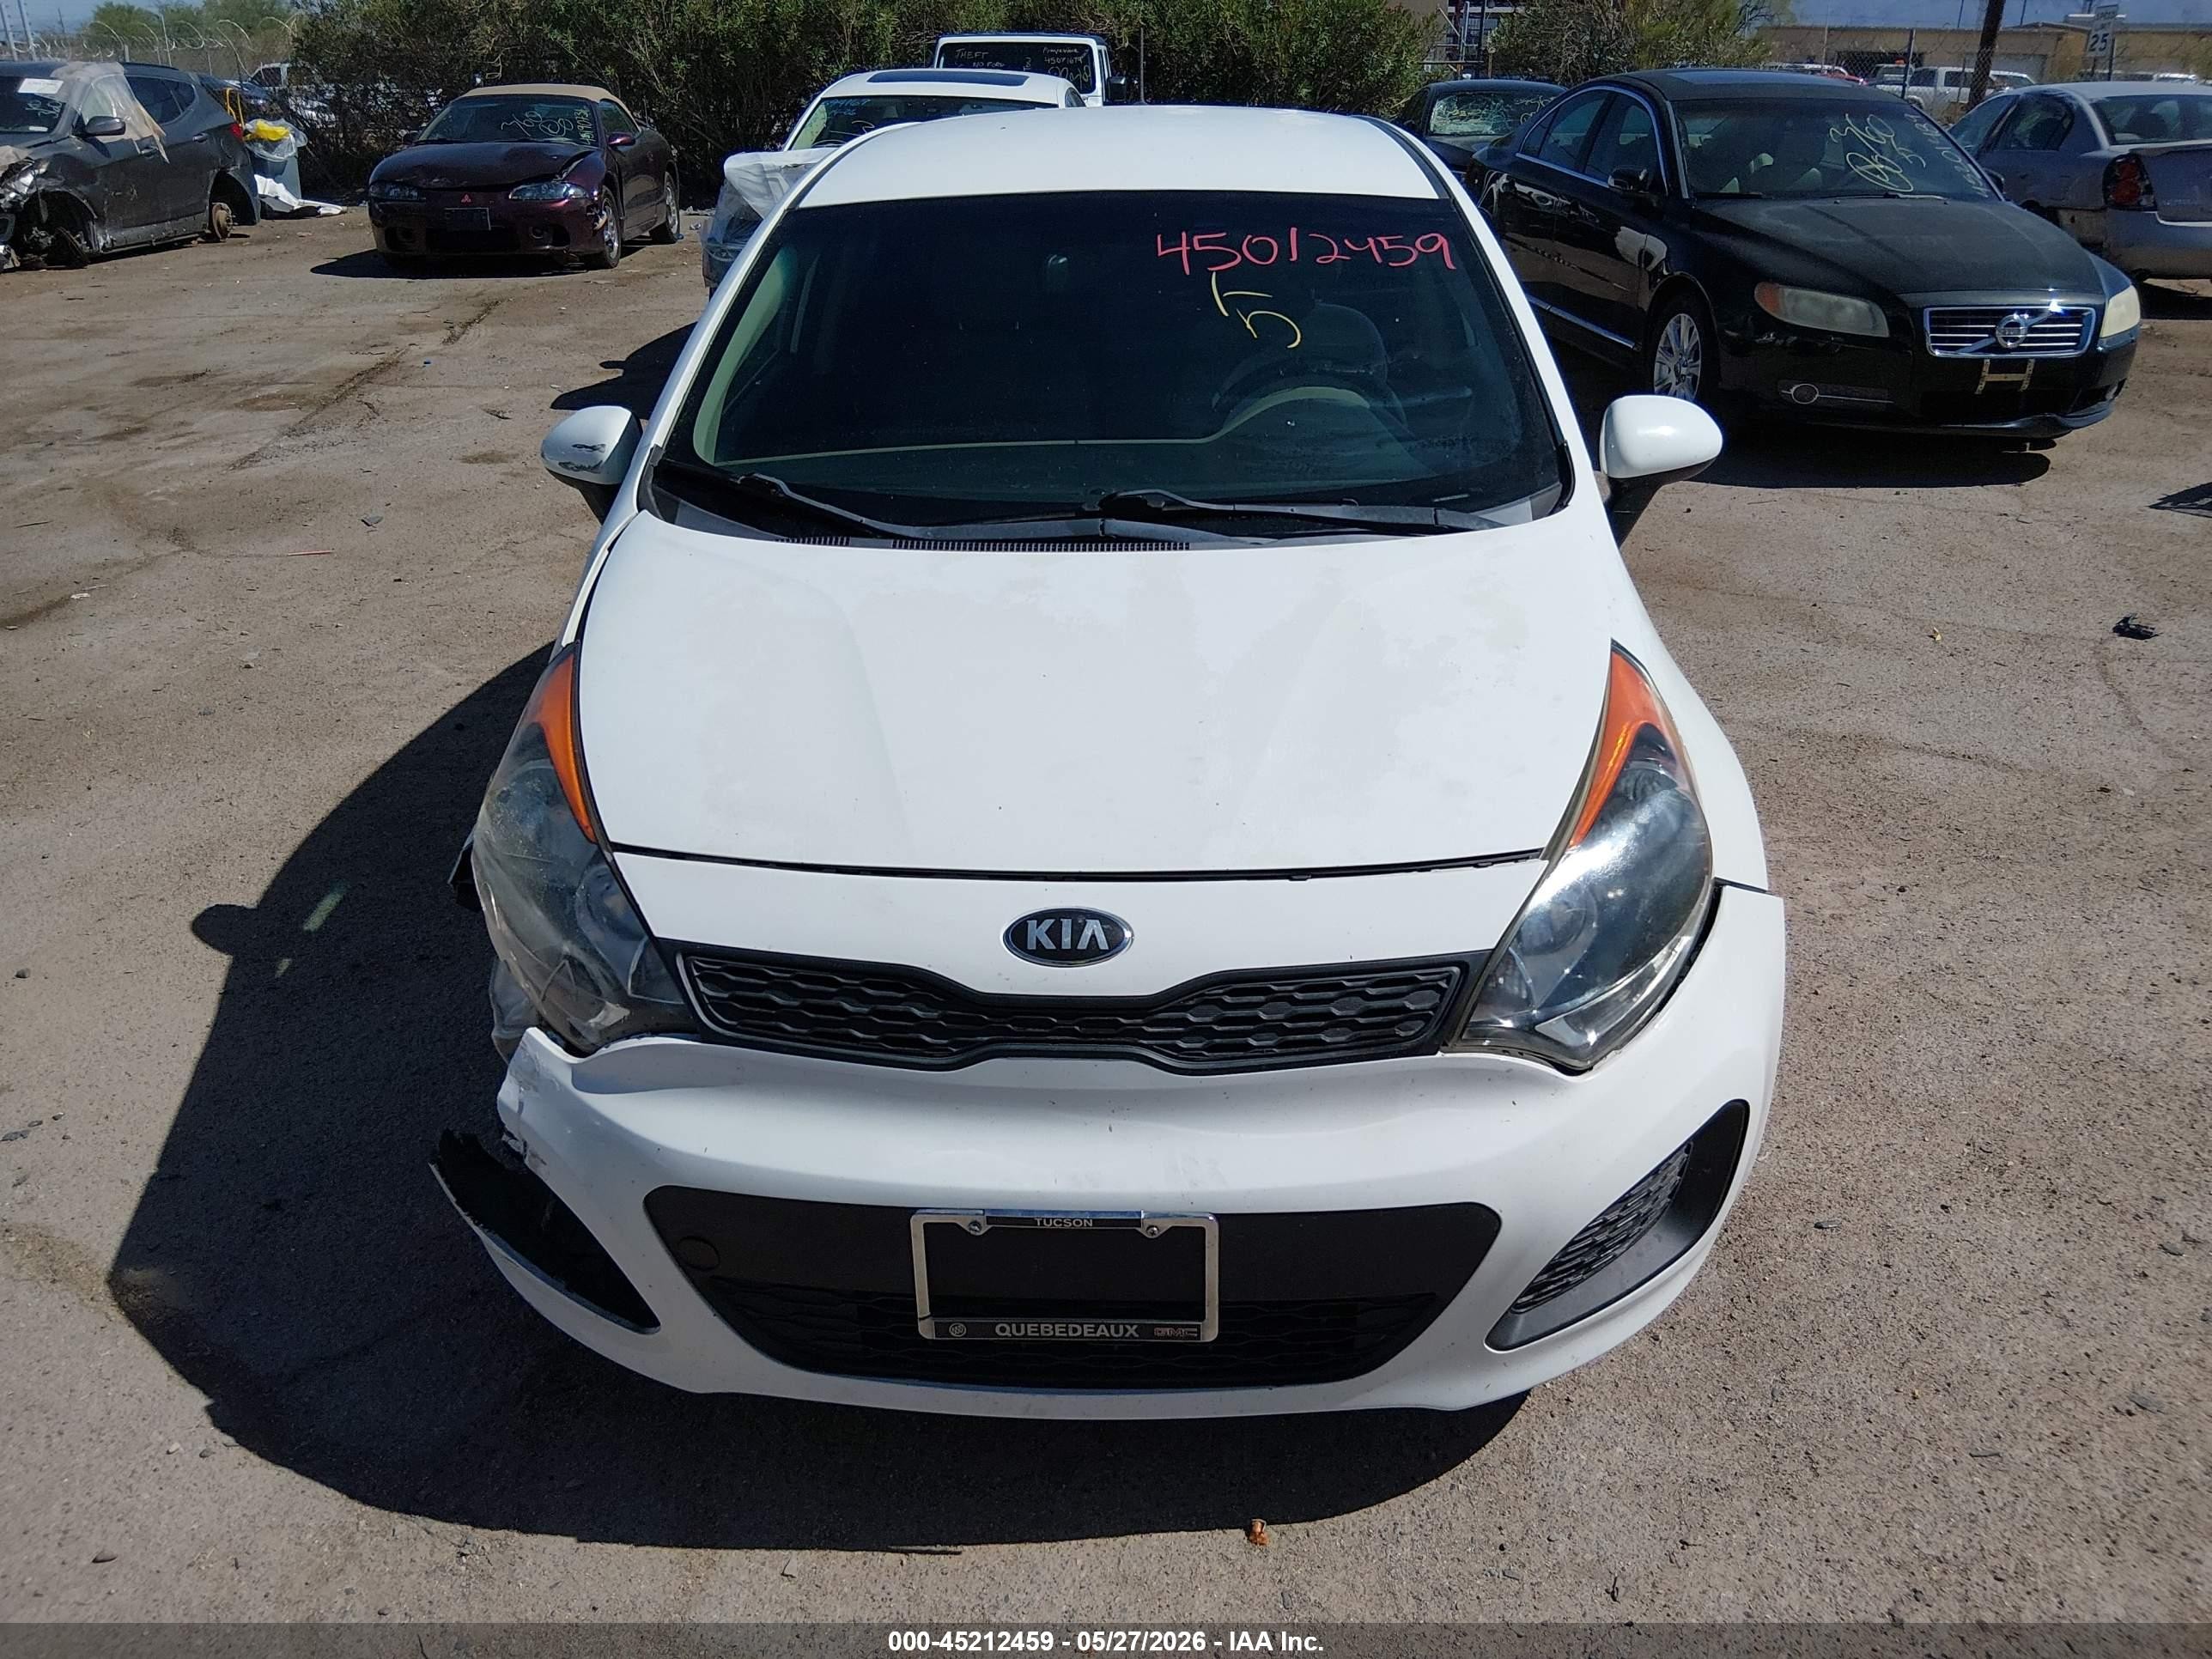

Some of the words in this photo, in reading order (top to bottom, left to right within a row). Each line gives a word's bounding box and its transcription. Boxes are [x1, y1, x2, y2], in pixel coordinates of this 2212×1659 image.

[2088, 33, 2110, 52] 25
[955, 47, 989, 59] THEFT
[1157, 227, 1457, 276] 45012459
[1026, 918, 1109, 951] KIA
[1034, 1217, 1093, 1228] TUCSON
[994, 1322, 1139, 1339] QUEBEDEAUX
